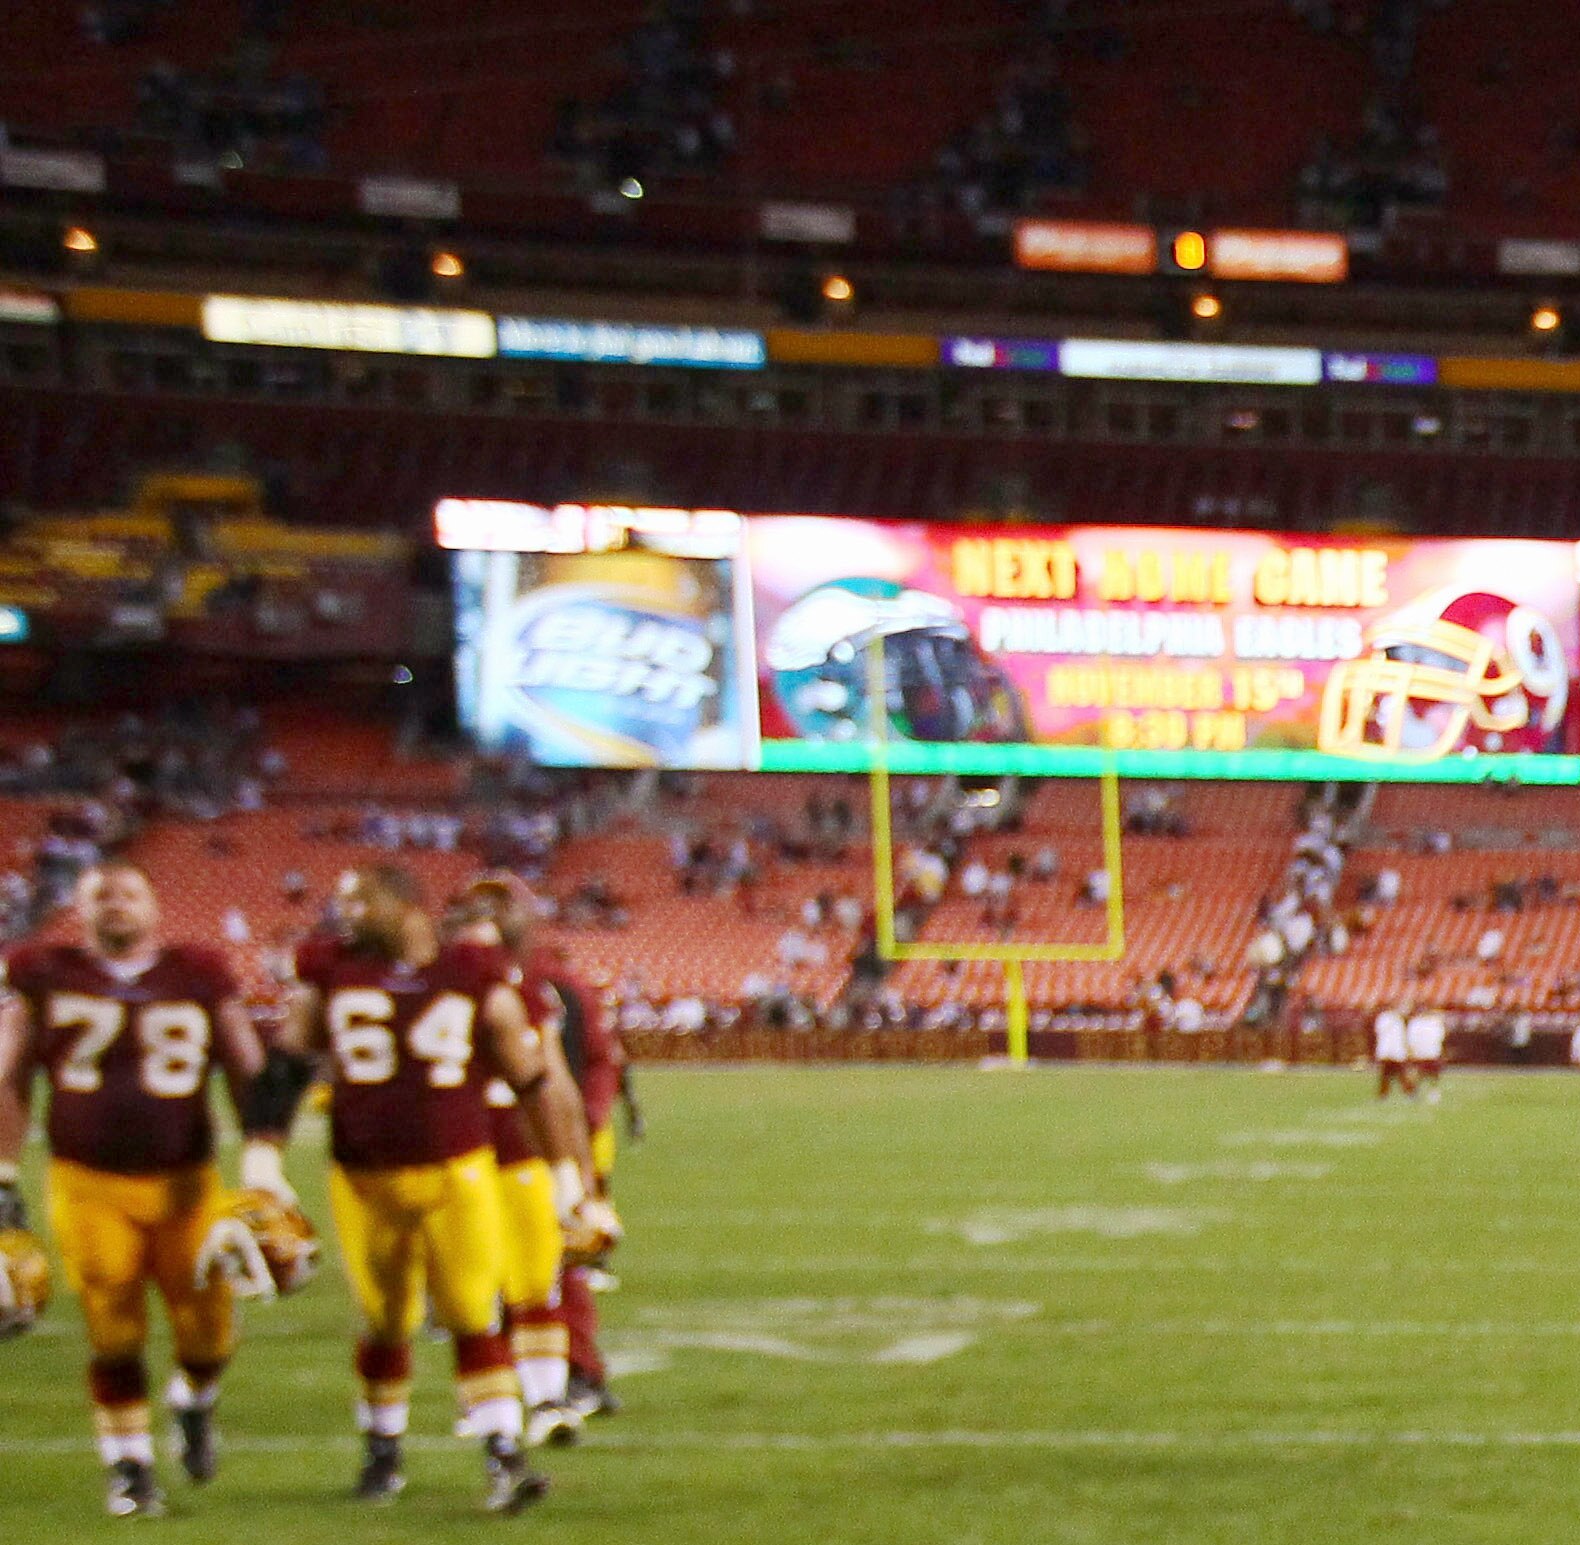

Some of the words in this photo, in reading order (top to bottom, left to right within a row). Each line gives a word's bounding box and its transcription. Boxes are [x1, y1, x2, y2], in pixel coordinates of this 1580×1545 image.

[951, 538, 1077, 600] NEXT
[1103, 548, 1232, 605] HOME
[1255, 547, 1389, 607] GAME
[979, 606, 1226, 657] PHILADELPHIA
[1233, 613, 1363, 660] EAGLES
[1046, 664, 1224, 709] NOVEMBER
[50, 992, 213, 1099] 78
[328, 987, 476, 1088] 64
